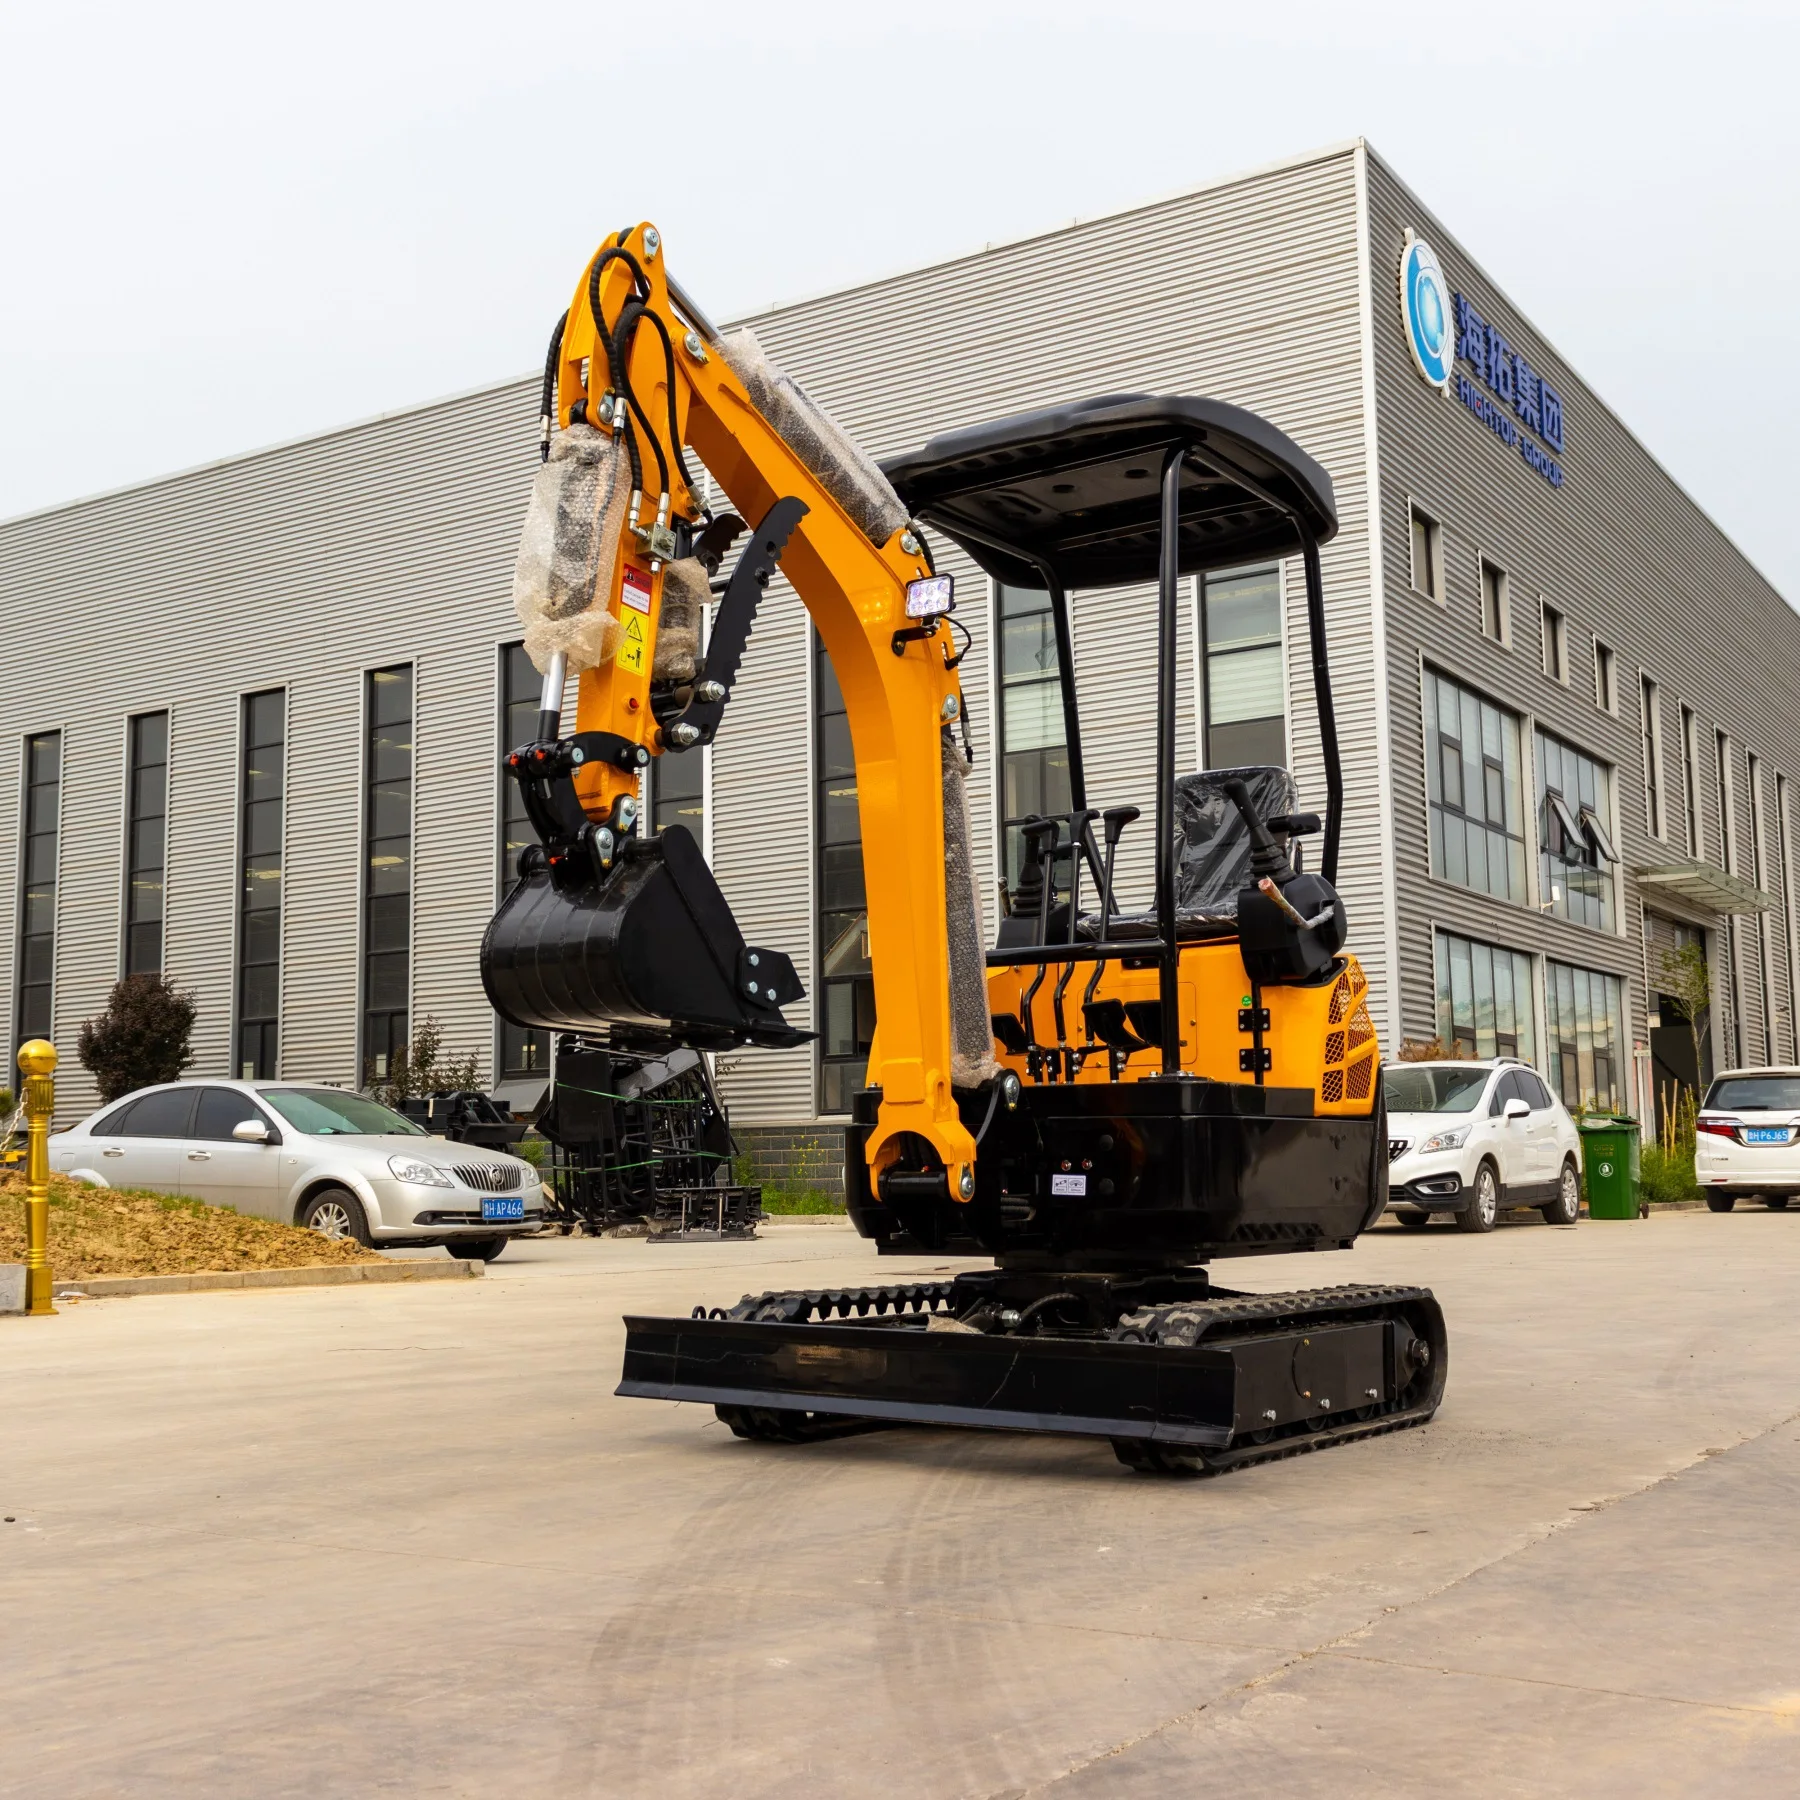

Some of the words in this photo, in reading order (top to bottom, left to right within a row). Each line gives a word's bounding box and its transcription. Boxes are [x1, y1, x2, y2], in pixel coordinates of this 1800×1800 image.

[1454, 293, 1565, 454] 海拓集团
[1457, 376, 1518, 447] HIGHTOP
[1521, 437, 1564, 488] GROUP
